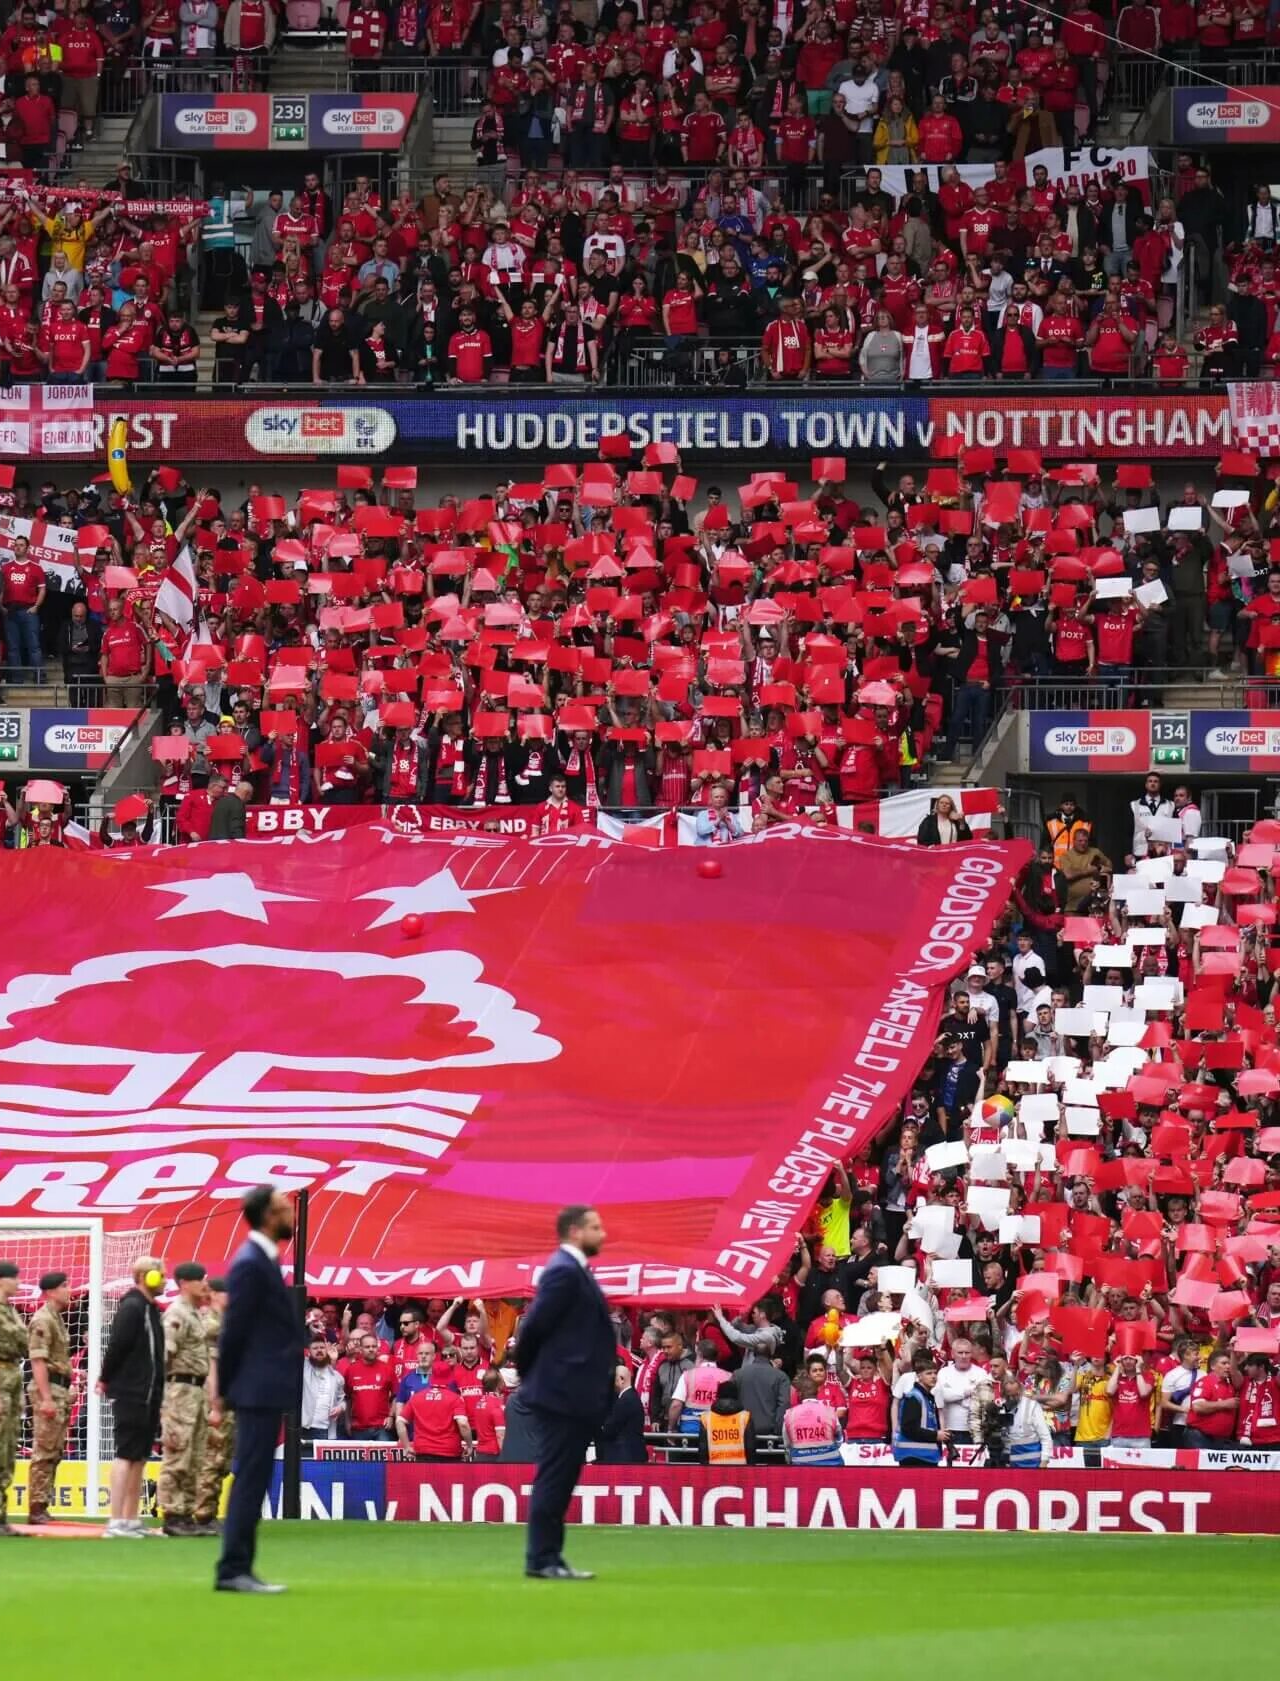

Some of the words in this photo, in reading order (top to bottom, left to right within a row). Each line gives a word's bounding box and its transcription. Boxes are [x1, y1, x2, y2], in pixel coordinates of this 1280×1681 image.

[183, 112, 205, 124] sky
[206, 112, 226, 123] bet
[274, 104, 304, 119] 239
[332, 112, 352, 124] sky
[353, 112, 375, 123] bet
[1196, 106, 1216, 119] sky
[1219, 107, 1241, 118] bet
[190, 124, 223, 132] PLAY-OFFS
[1202, 119, 1236, 127] PLAY-OFFS
[127, 201, 154, 213] BRIAN
[163, 202, 195, 213] CLOUGH
[54, 334, 76, 342] BOXT
[1048, 328, 1072, 337] BOXT
[47, 387, 89, 400] JORDAN
[263, 414, 299, 436] sky
[303, 412, 343, 432] bet
[782, 410, 906, 448] TOWN
[916, 421, 935, 447] v
[946, 408, 1230, 447] NOTTINGHAM
[43, 430, 92, 445] ENGLAND
[356, 437, 376, 448] EFL
[7, 539, 62, 561] FREST
[1103, 623, 1127, 632] BOXT
[1060, 630, 1084, 640] BOXT
[55, 727, 76, 743] sky
[79, 728, 102, 741] bet
[1055, 730, 1077, 745] sky
[1080, 731, 1104, 744] bet
[1153, 723, 1186, 740] 134
[1216, 730, 1238, 745] sky
[1241, 731, 1264, 744] bet
[60, 742, 97, 751] PLAY-OFFS
[1061, 745, 1098, 754] PLAY-OFFS
[1111, 745, 1125, 753] EFL
[1222, 745, 1259, 754] PLAY-OFFS
[246, 808, 331, 832] BBY
[499, 818, 528, 834] ND
[854, 977, 928, 1072] ANFIELD
[823, 1073, 887, 1120] THE
[768, 1117, 858, 1195] PLACES
[715, 1199, 803, 1279] WE'VE
[281, 1260, 487, 1288] MAIN
[796, 1427, 826, 1441] RT244
[1207, 1452, 1228, 1465] WE
[1231, 1453, 1272, 1466] WANT
[419, 1482, 917, 1530] NOTINGHAM
[941, 1488, 1214, 1534] FOREST
